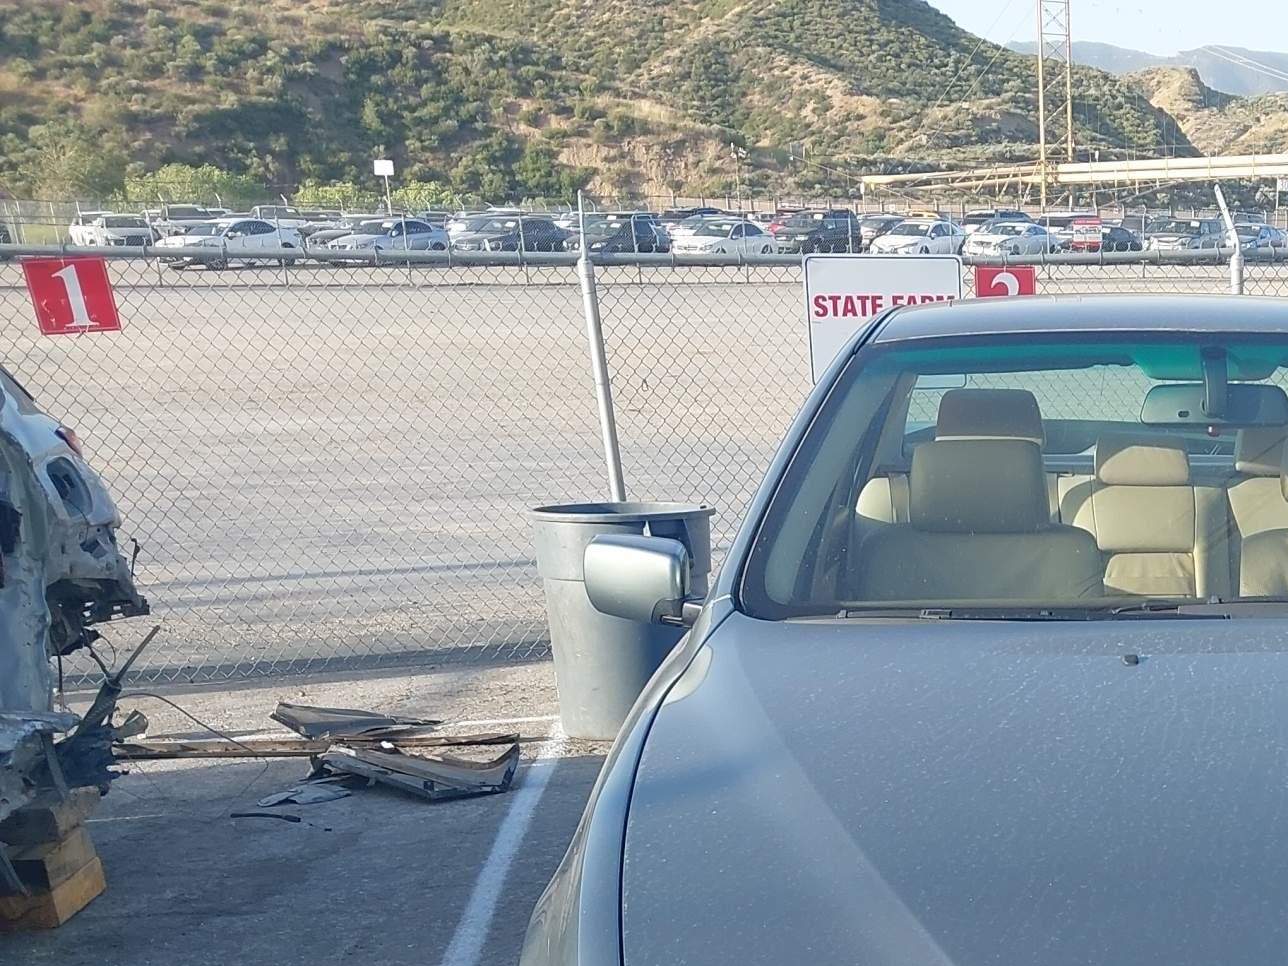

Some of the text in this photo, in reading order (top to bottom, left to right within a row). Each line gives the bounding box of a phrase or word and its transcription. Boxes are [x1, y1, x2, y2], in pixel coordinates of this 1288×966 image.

[51, 264, 99, 327] 1
[813, 294, 956, 318] STATE FA
